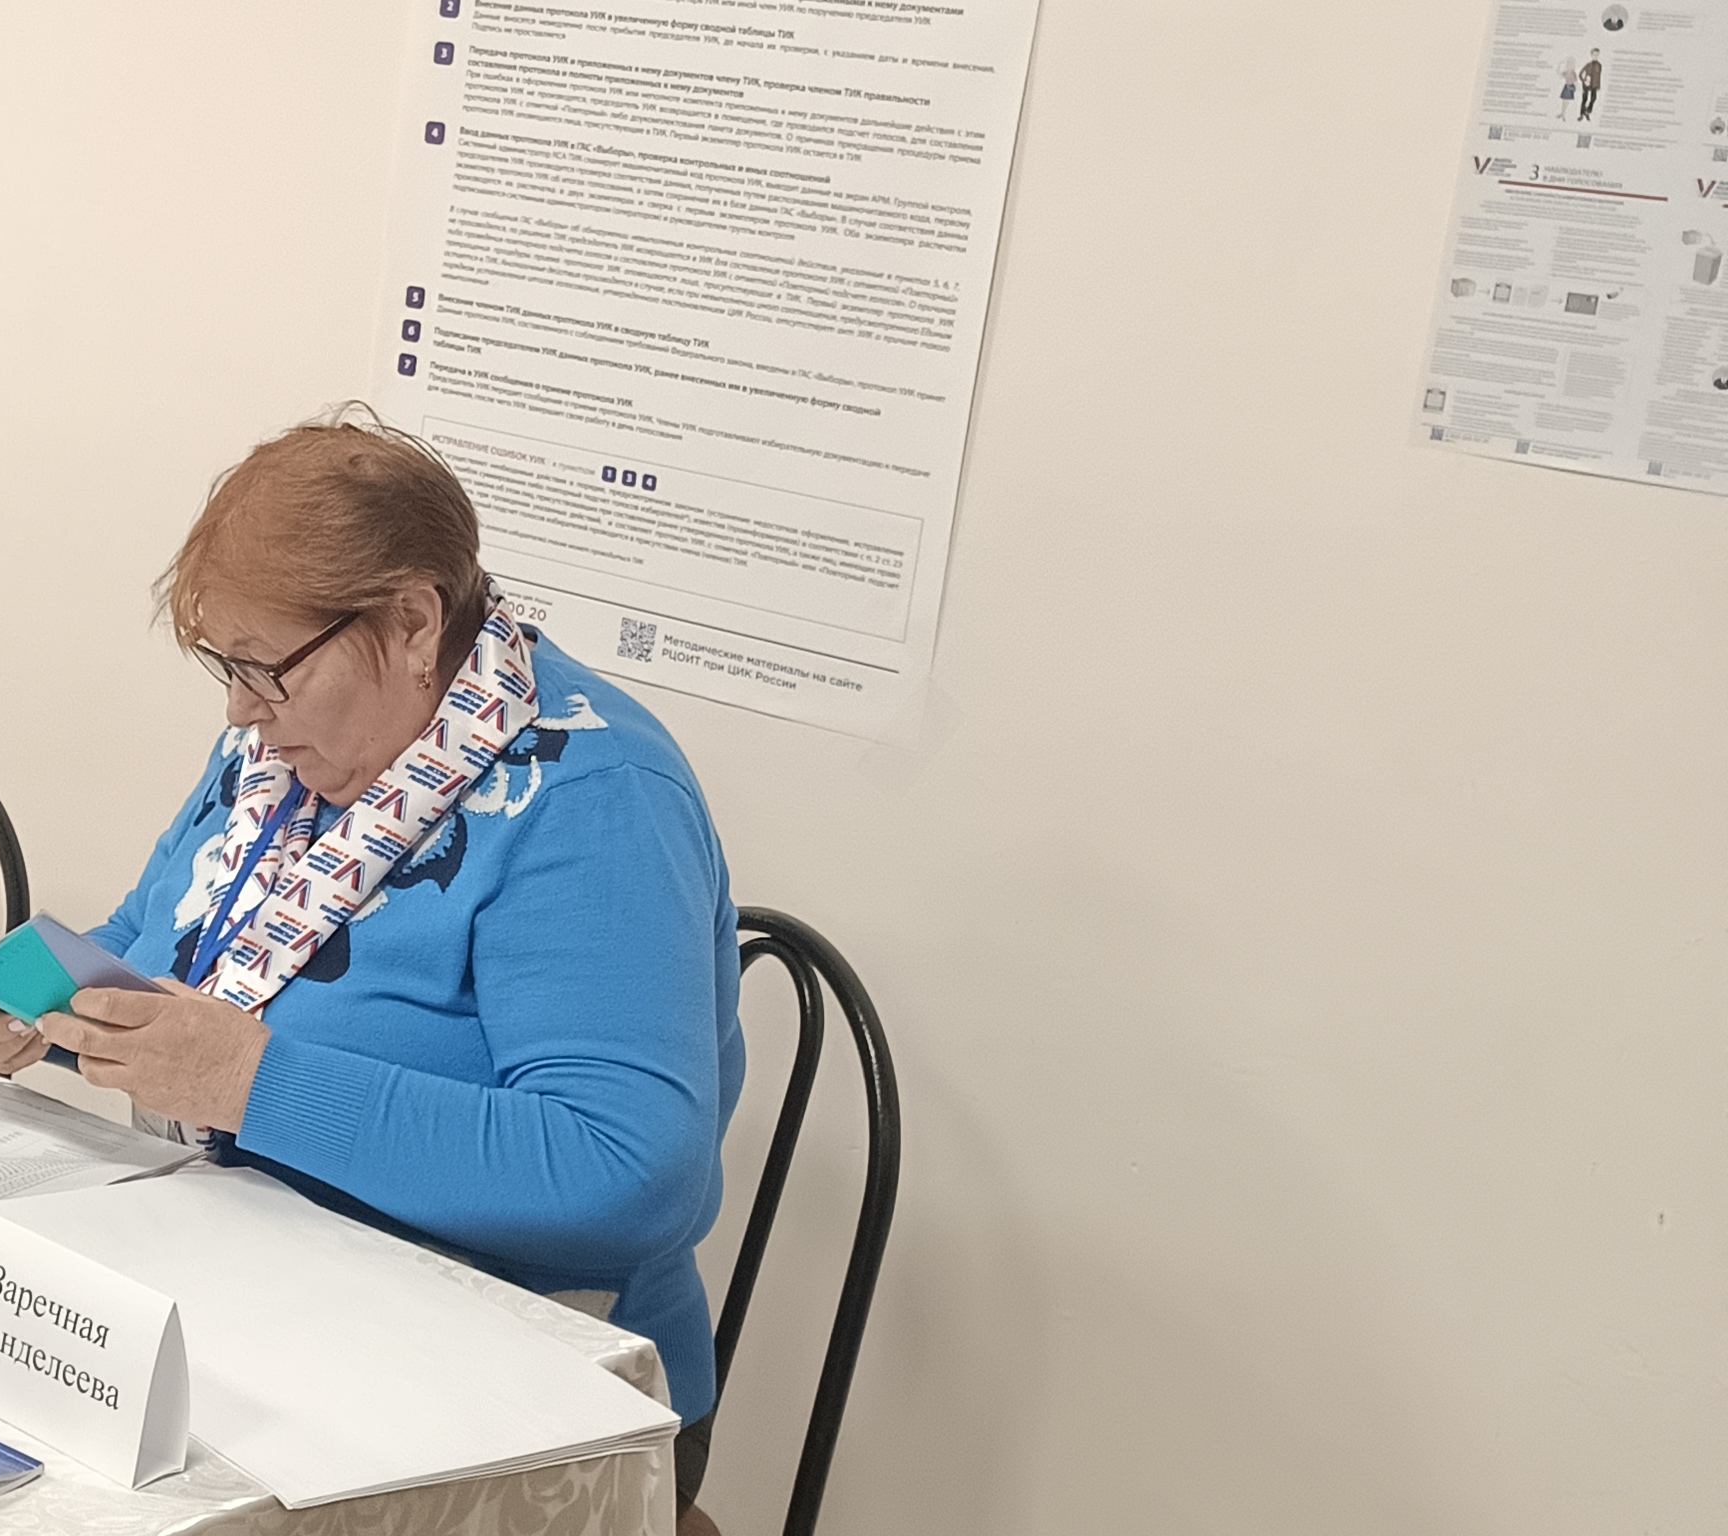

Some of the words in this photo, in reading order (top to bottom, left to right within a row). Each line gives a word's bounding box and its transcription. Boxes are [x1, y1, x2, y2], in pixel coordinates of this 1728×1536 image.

[1529, 164, 1539, 180] 3
[528, 607, 547, 621] 20
[660, 647, 701, 667] РЦОИТ
[702, 659, 724, 673] при
[726, 664, 753, 679] ЦИК
[754, 671, 797, 690] России
[662, 634, 744, 662] Методические
[745, 656, 810, 679] материалы
[811, 672, 827, 682] на
[828, 674, 863, 692] сайте
